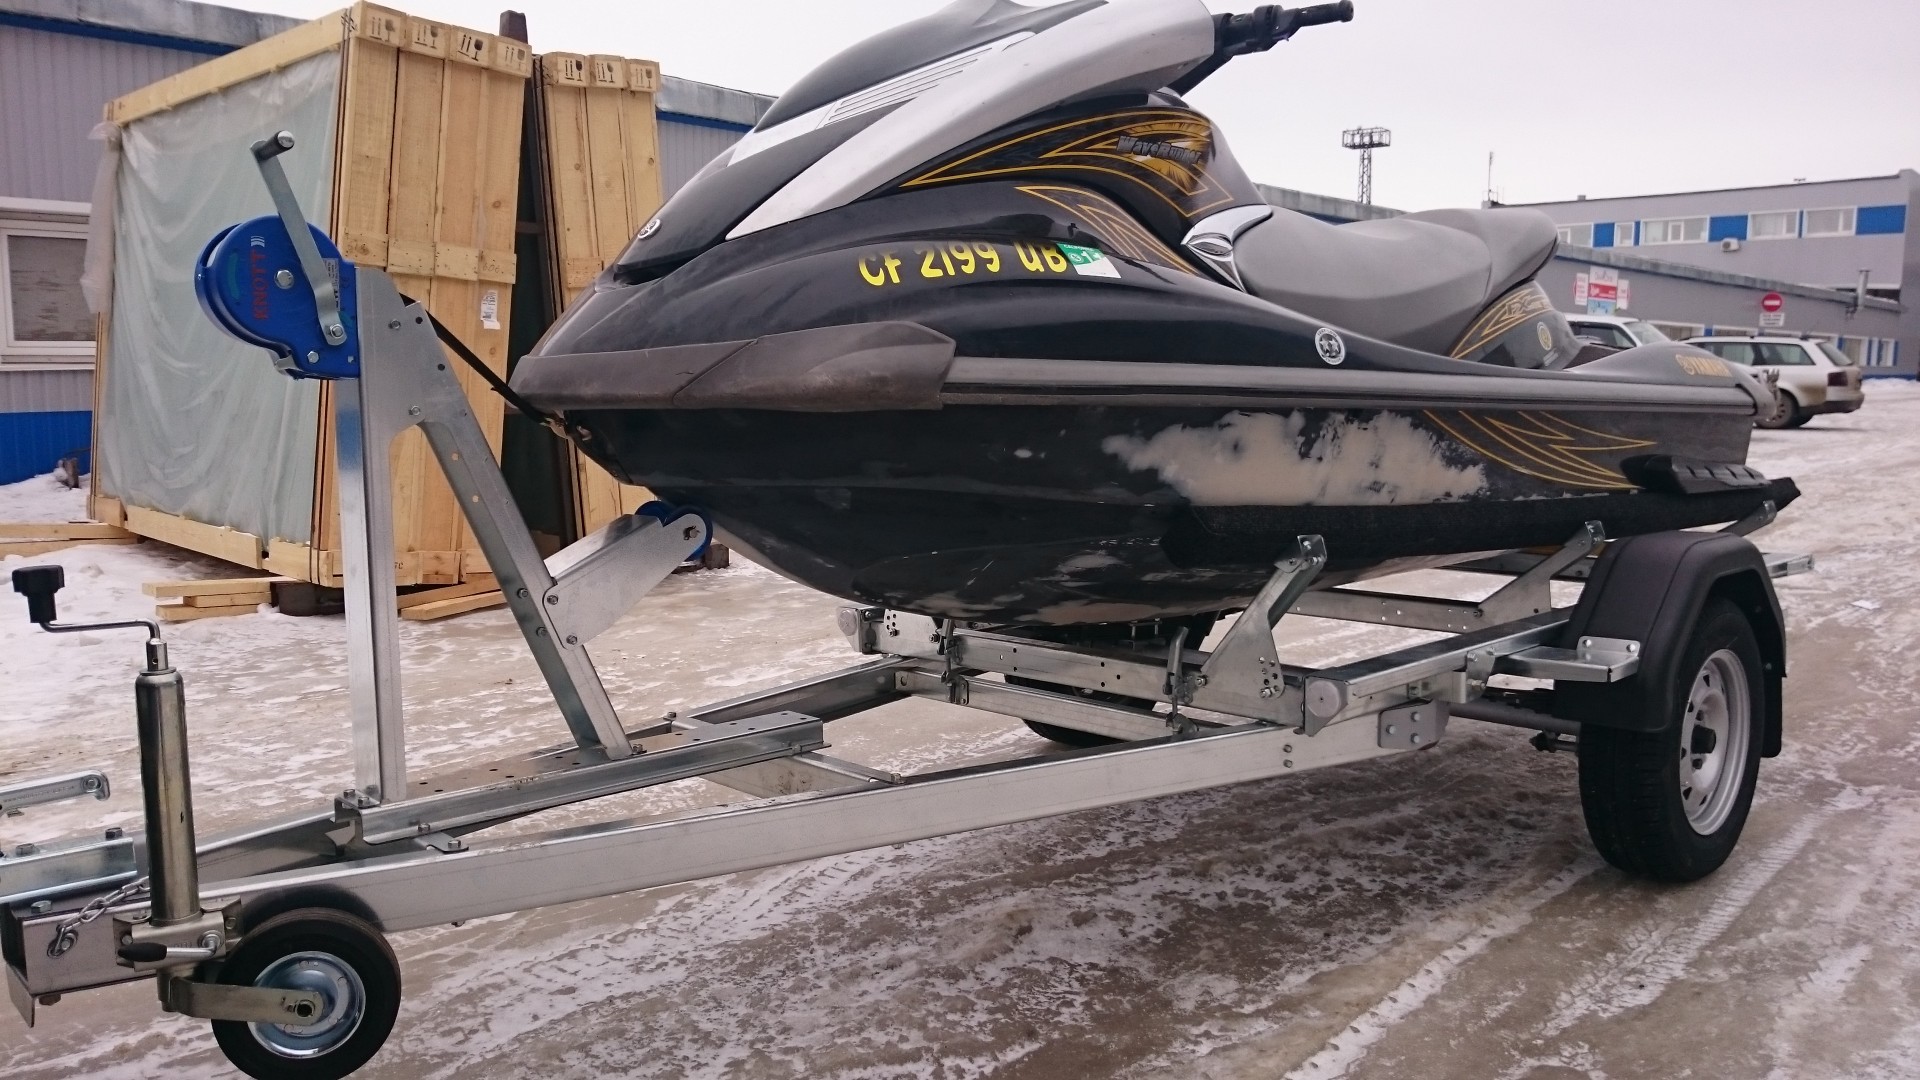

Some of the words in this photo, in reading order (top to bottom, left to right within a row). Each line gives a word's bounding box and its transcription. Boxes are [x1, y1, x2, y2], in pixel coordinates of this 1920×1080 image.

[1116, 135, 1203, 166] WaveRunner
[250, 249, 269, 319] KNOTT
[858, 250, 901, 286] CF
[914, 239, 1001, 278] 2199
[1013, 239, 1068, 273] UB
